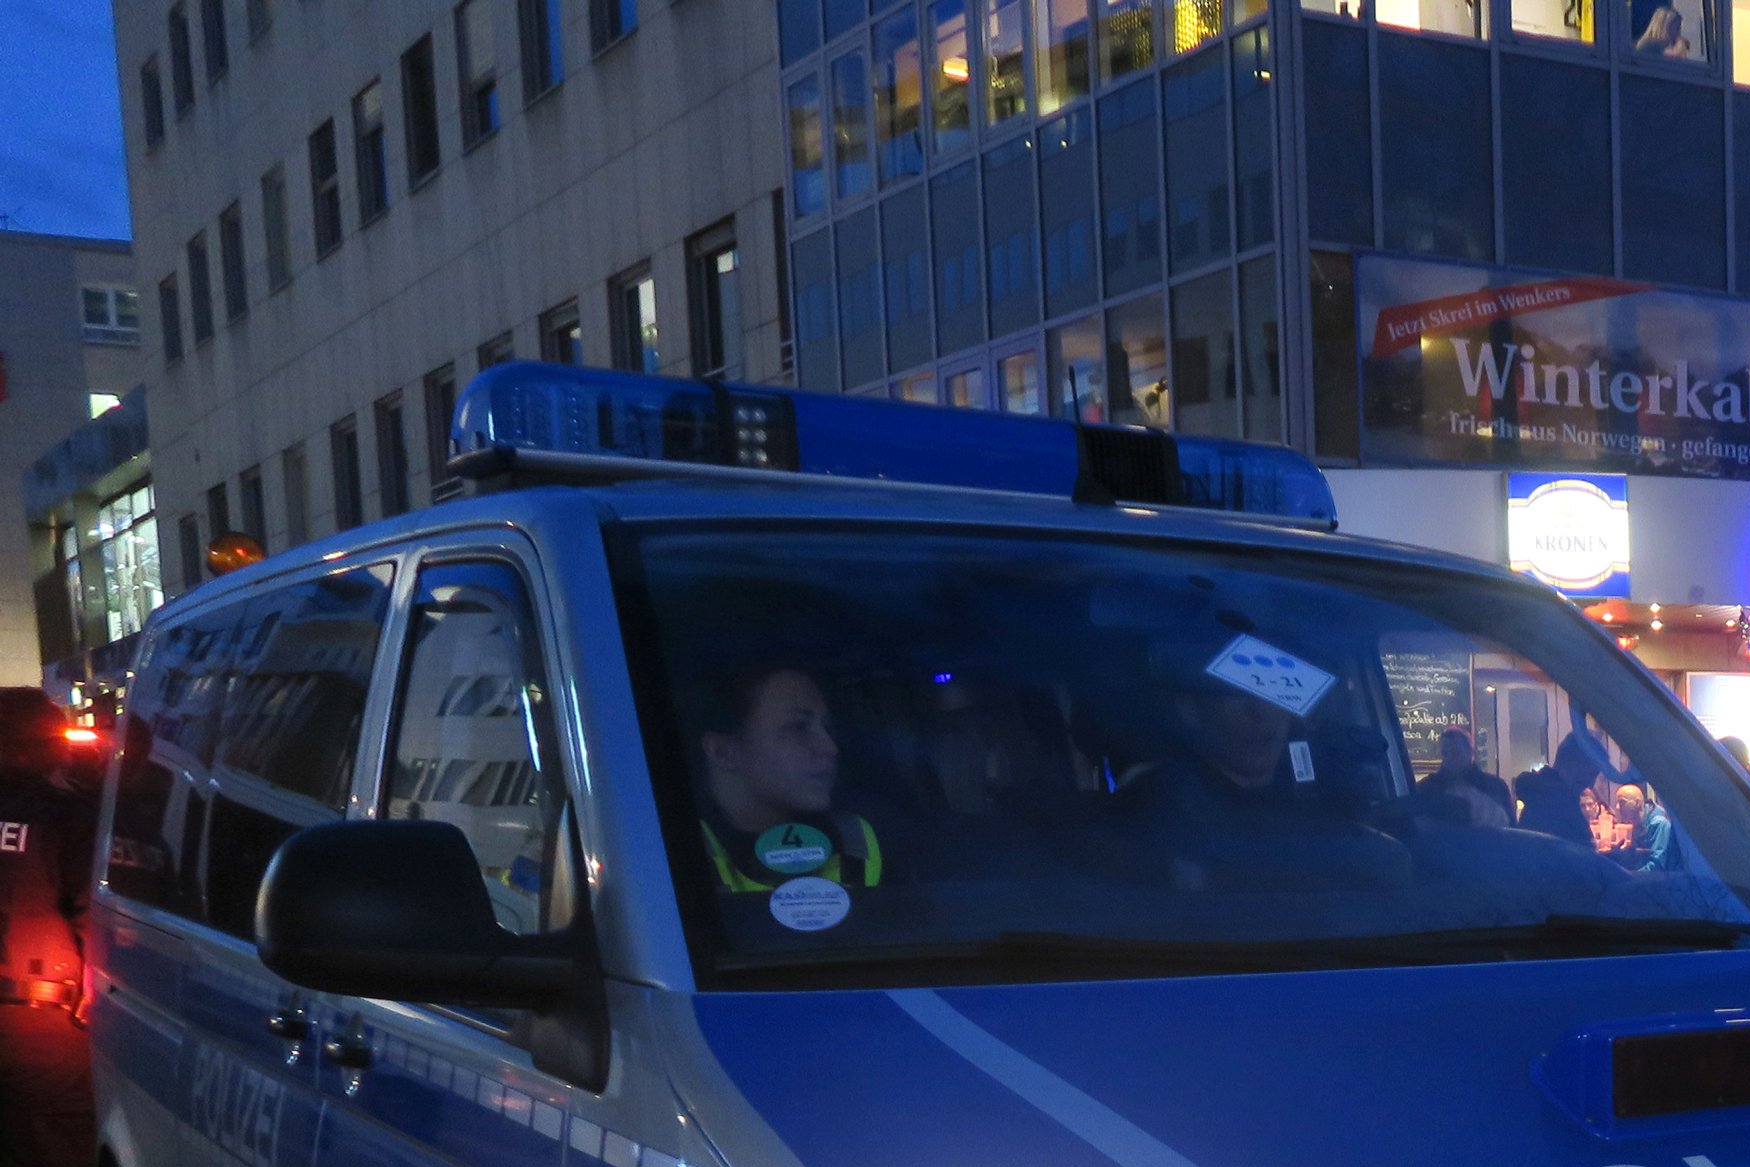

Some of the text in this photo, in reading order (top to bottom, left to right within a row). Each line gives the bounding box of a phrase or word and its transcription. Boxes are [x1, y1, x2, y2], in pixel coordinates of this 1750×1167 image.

[1388, 318, 1426, 342] Jetzt
[1476, 299, 1497, 315] im
[1500, 286, 1571, 311] Wenkers
[1563, 423, 1666, 454] Norwegen
[0, 820, 29, 853] EI
[781, 825, 803, 849] 4
